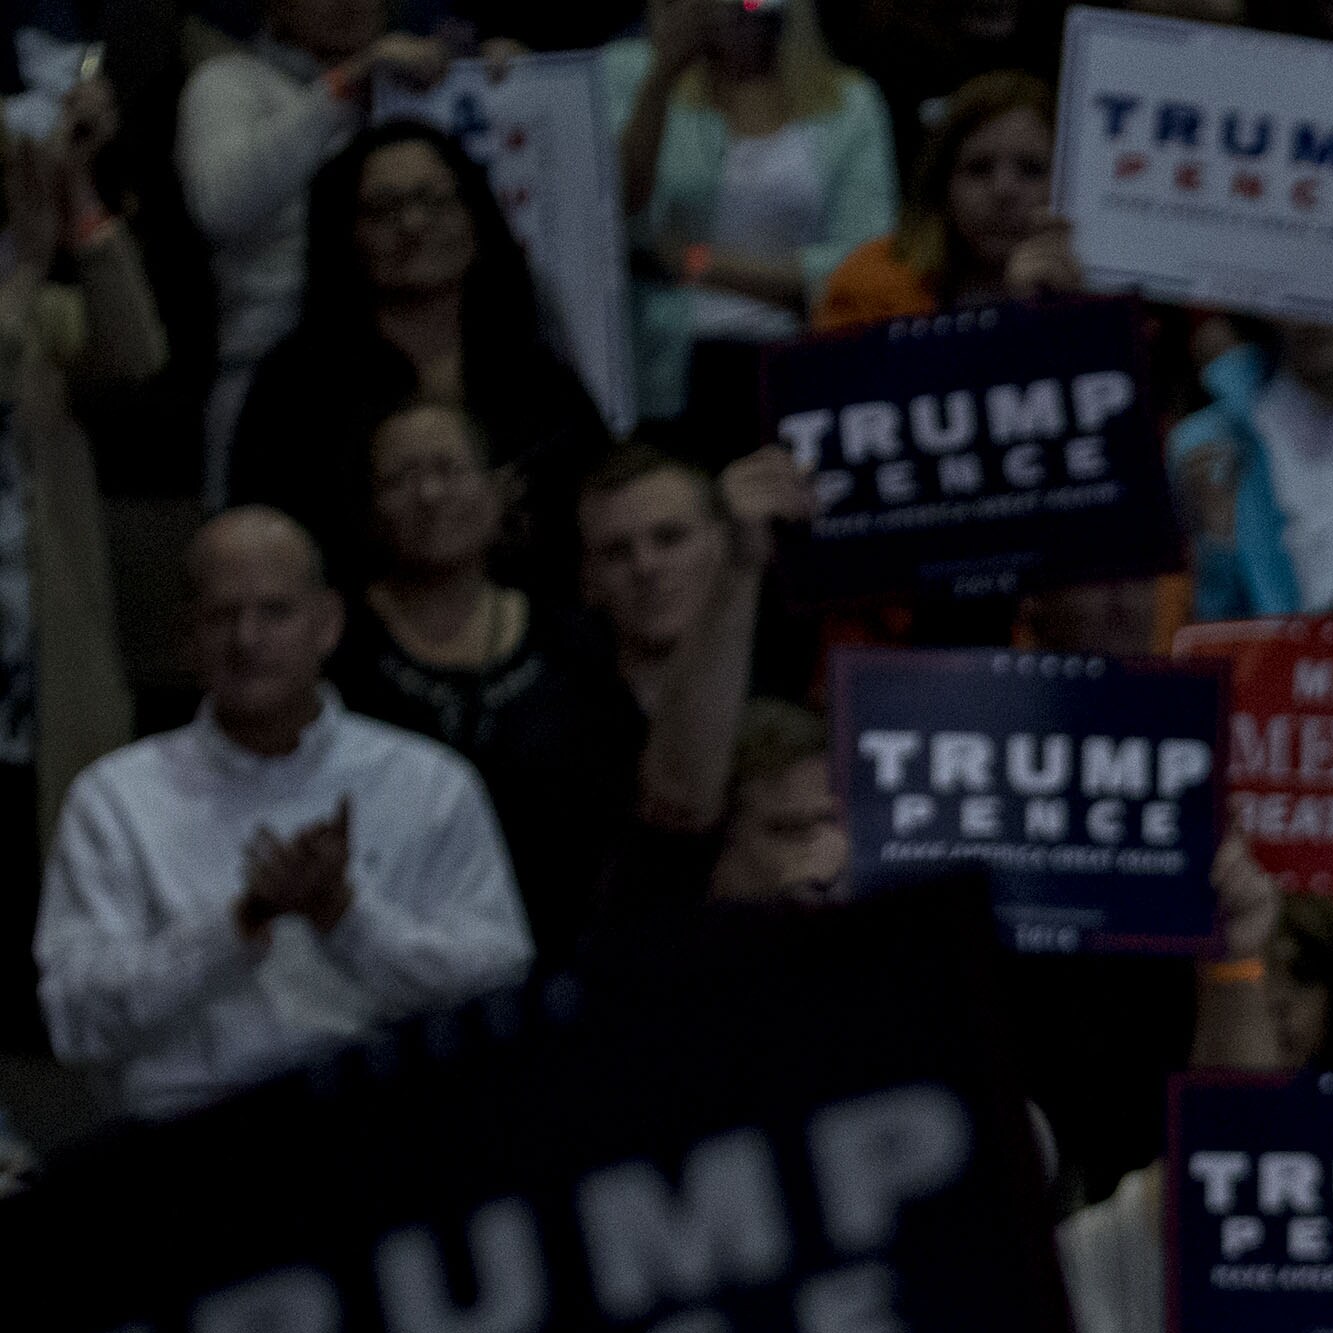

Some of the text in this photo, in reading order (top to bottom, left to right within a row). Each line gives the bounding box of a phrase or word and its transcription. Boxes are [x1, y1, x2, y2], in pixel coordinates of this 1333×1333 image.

[777, 368, 1135, 474] TRUMP
[858, 730, 1213, 799] TRUMP
[893, 794, 1183, 848] PENCE
